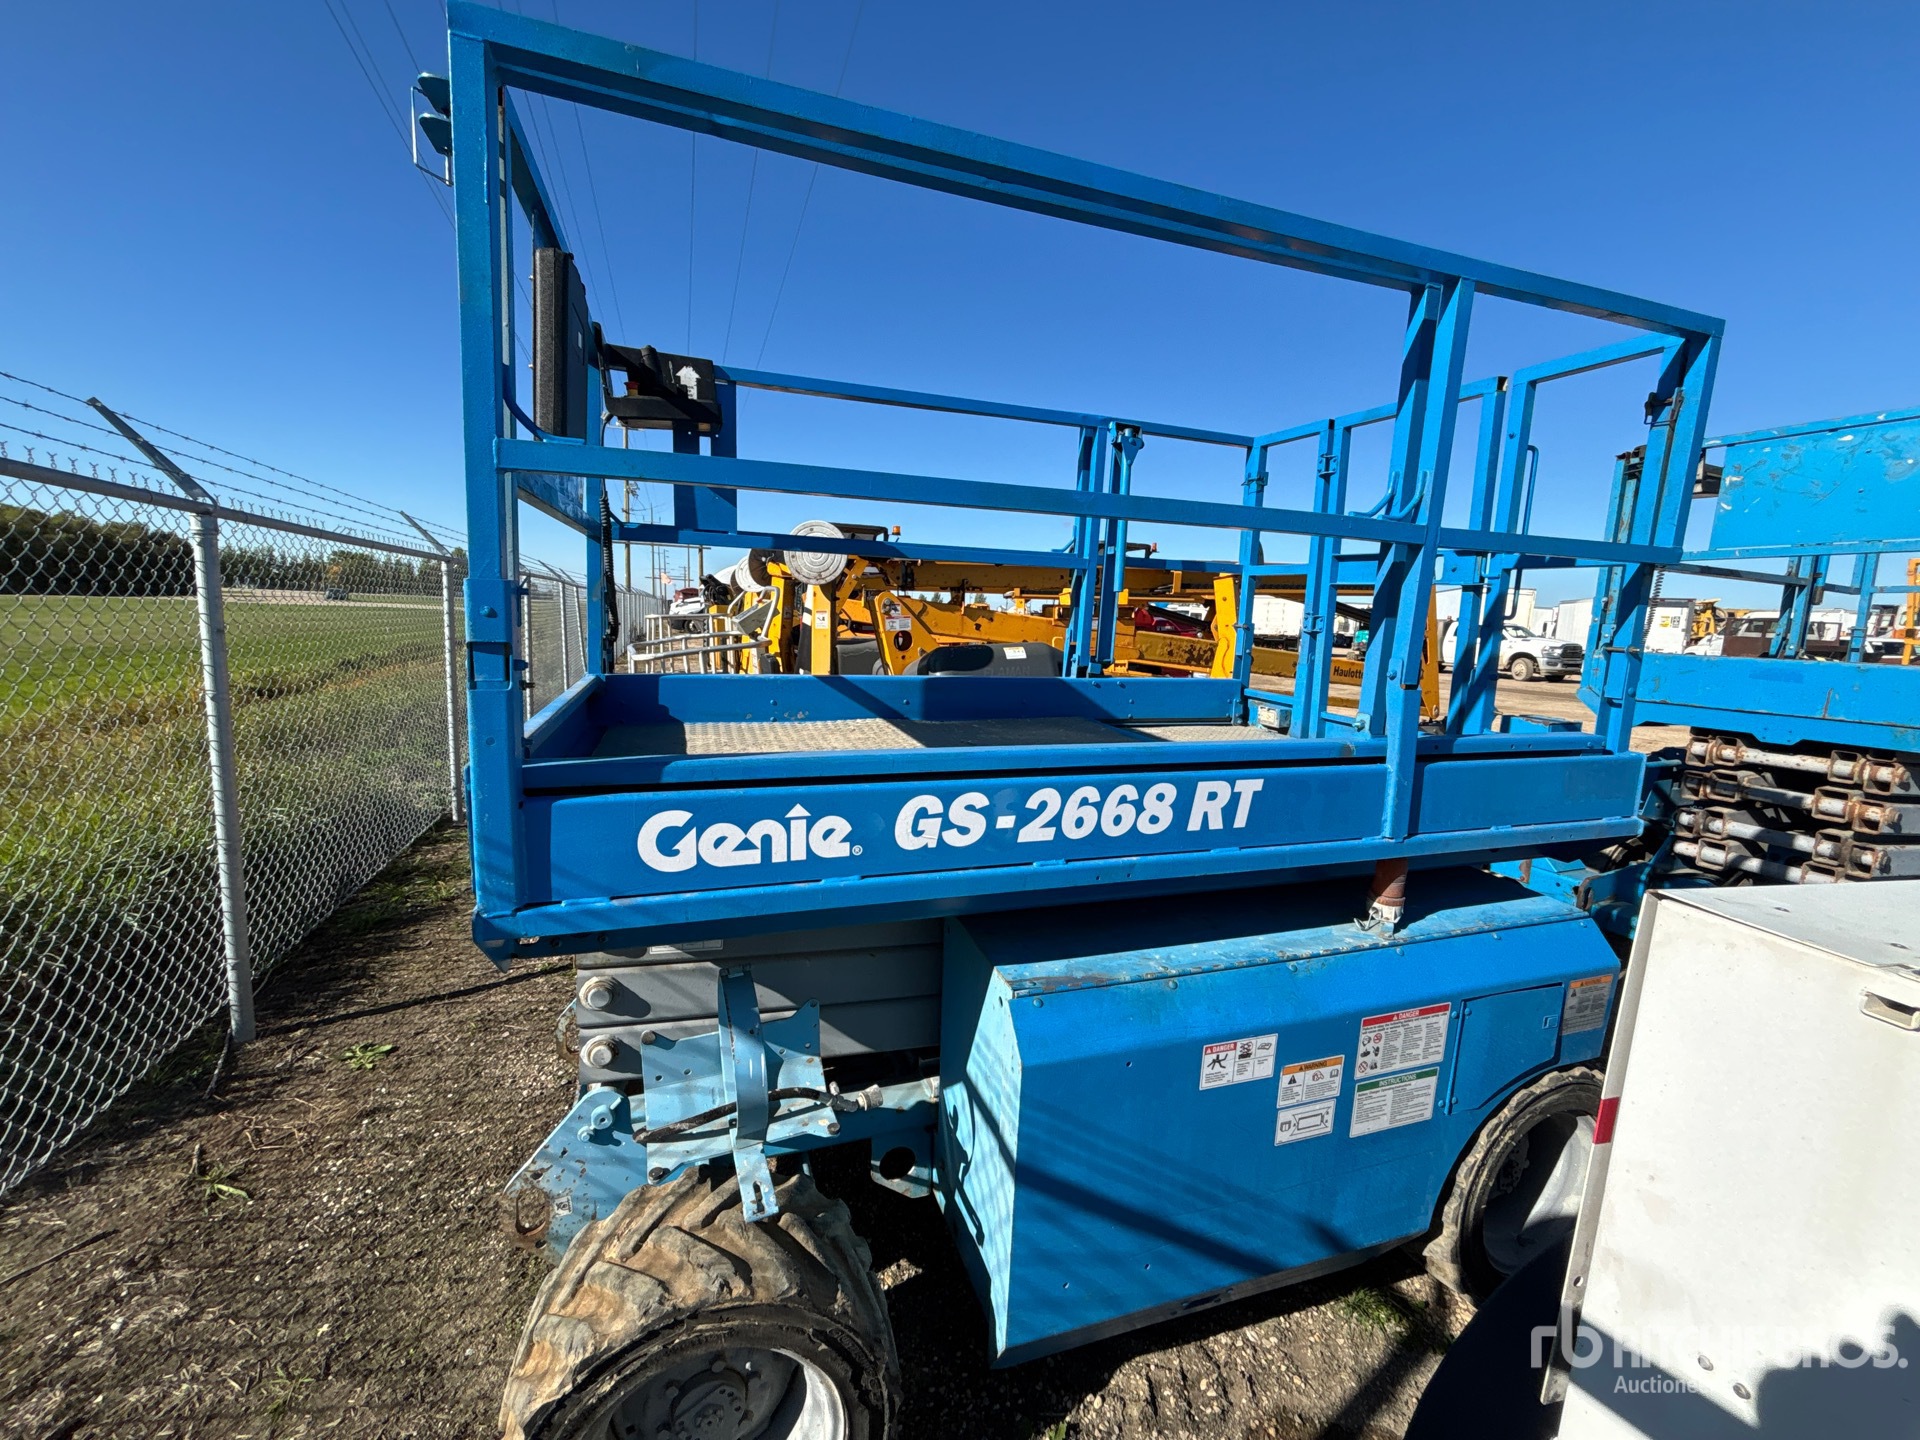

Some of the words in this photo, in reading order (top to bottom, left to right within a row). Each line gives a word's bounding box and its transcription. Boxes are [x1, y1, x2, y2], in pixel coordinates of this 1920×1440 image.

[637, 803, 853, 873] Genie
[894, 782, 1178, 851] GS-2668
[1186, 778, 1264, 832] RT
[1398, 1010, 1420, 1020] DANGER
[1212, 1043, 1235, 1053] DANGER
[1304, 1060, 1328, 1070] WARNING
[1379, 1074, 1417, 1087] INSTRUCTIONS
